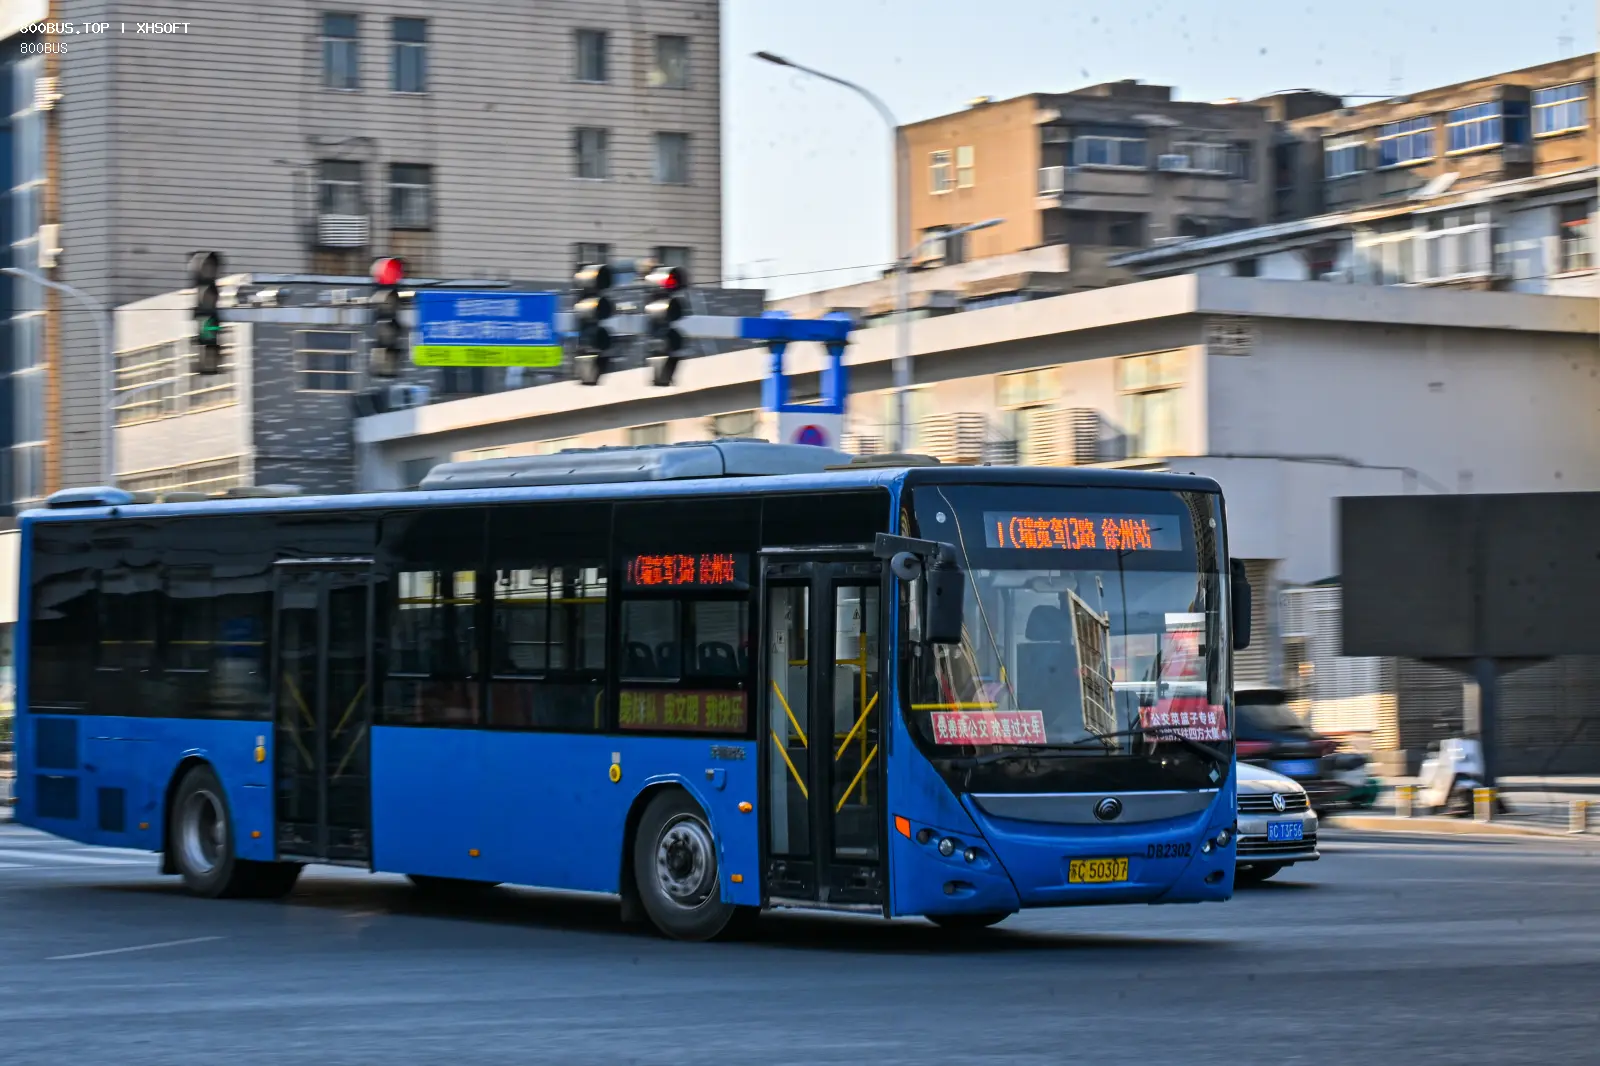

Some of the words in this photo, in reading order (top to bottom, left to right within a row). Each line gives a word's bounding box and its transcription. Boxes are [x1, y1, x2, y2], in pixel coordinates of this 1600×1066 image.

[1101, 518, 1152, 550] 徐州站
[937, 714, 989, 738] 免费乘公交
[1150, 711, 1217, 726] 公交菜篮子专线
[1147, 842, 1193, 859] DB2302
